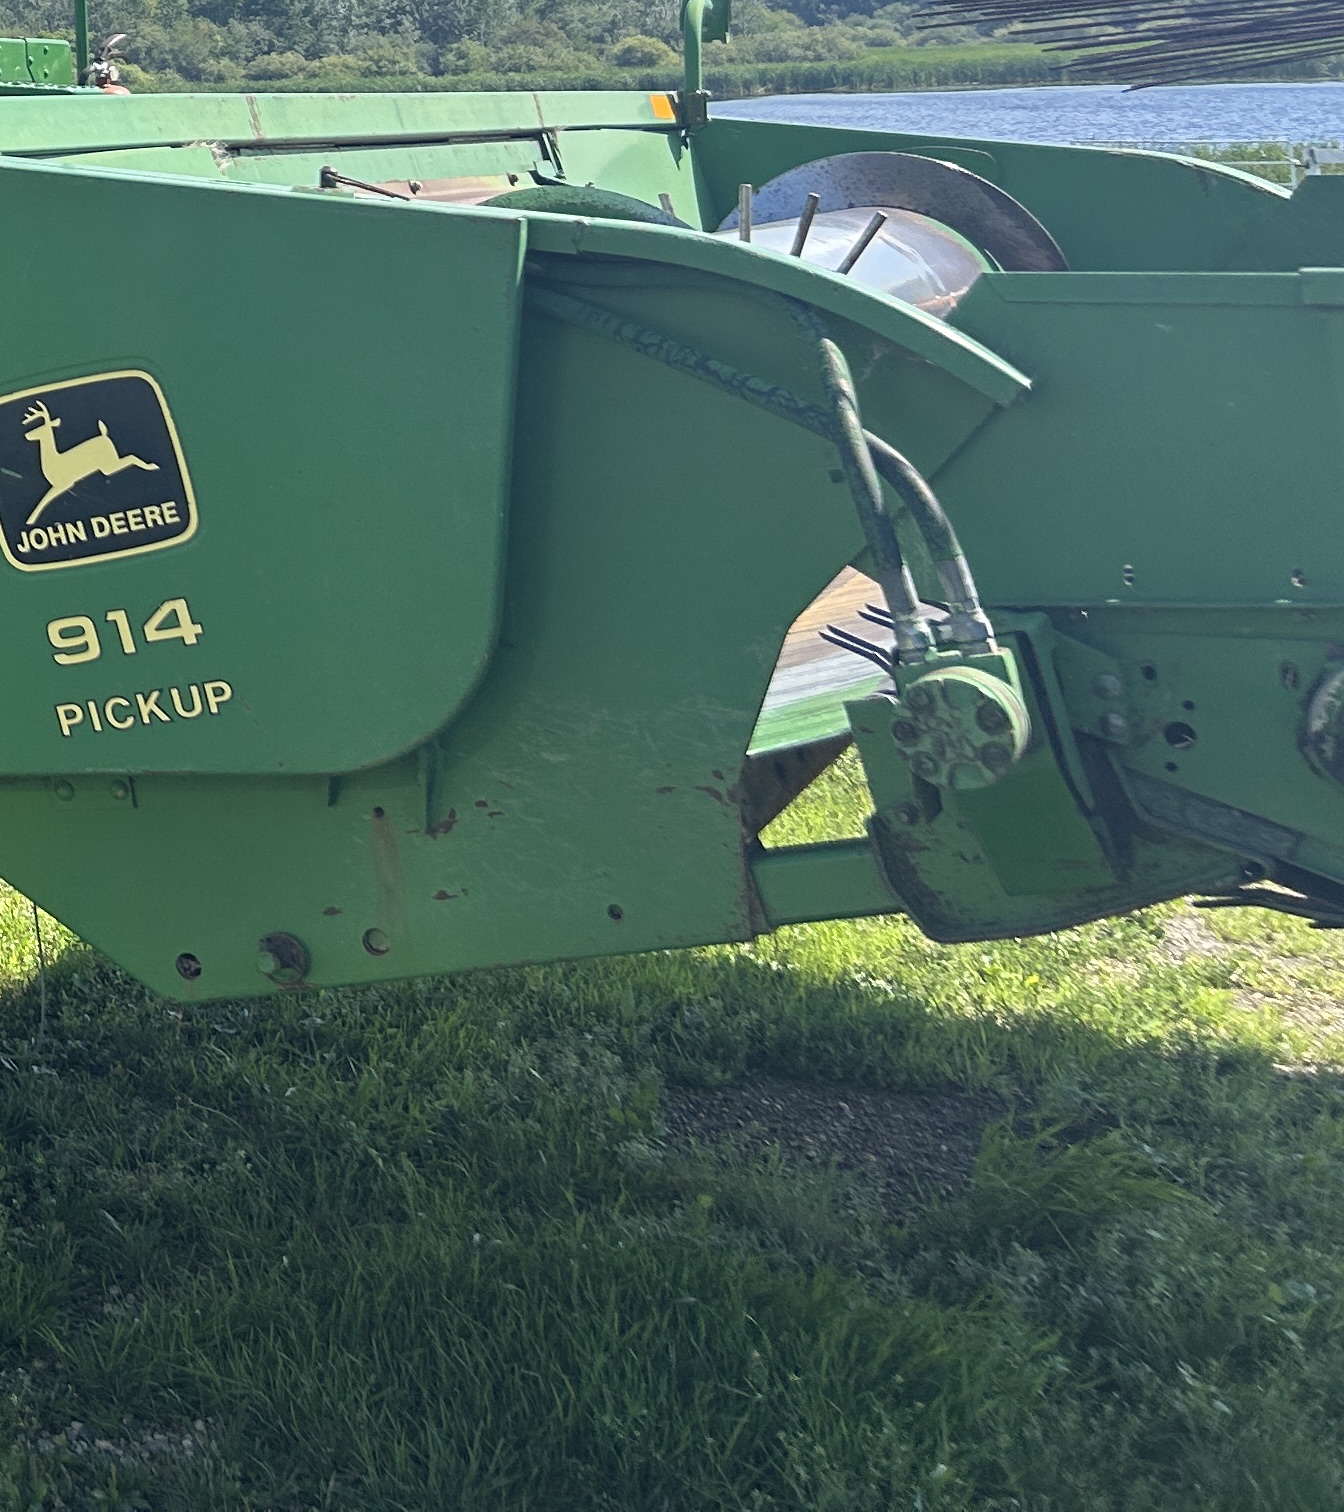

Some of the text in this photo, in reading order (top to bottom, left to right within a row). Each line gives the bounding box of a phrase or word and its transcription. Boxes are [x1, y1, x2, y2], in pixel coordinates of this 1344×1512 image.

[17, 501, 181, 553] JOHN DEERE
[46, 597, 203, 665] 914
[55, 679, 234, 737] PICKUP
